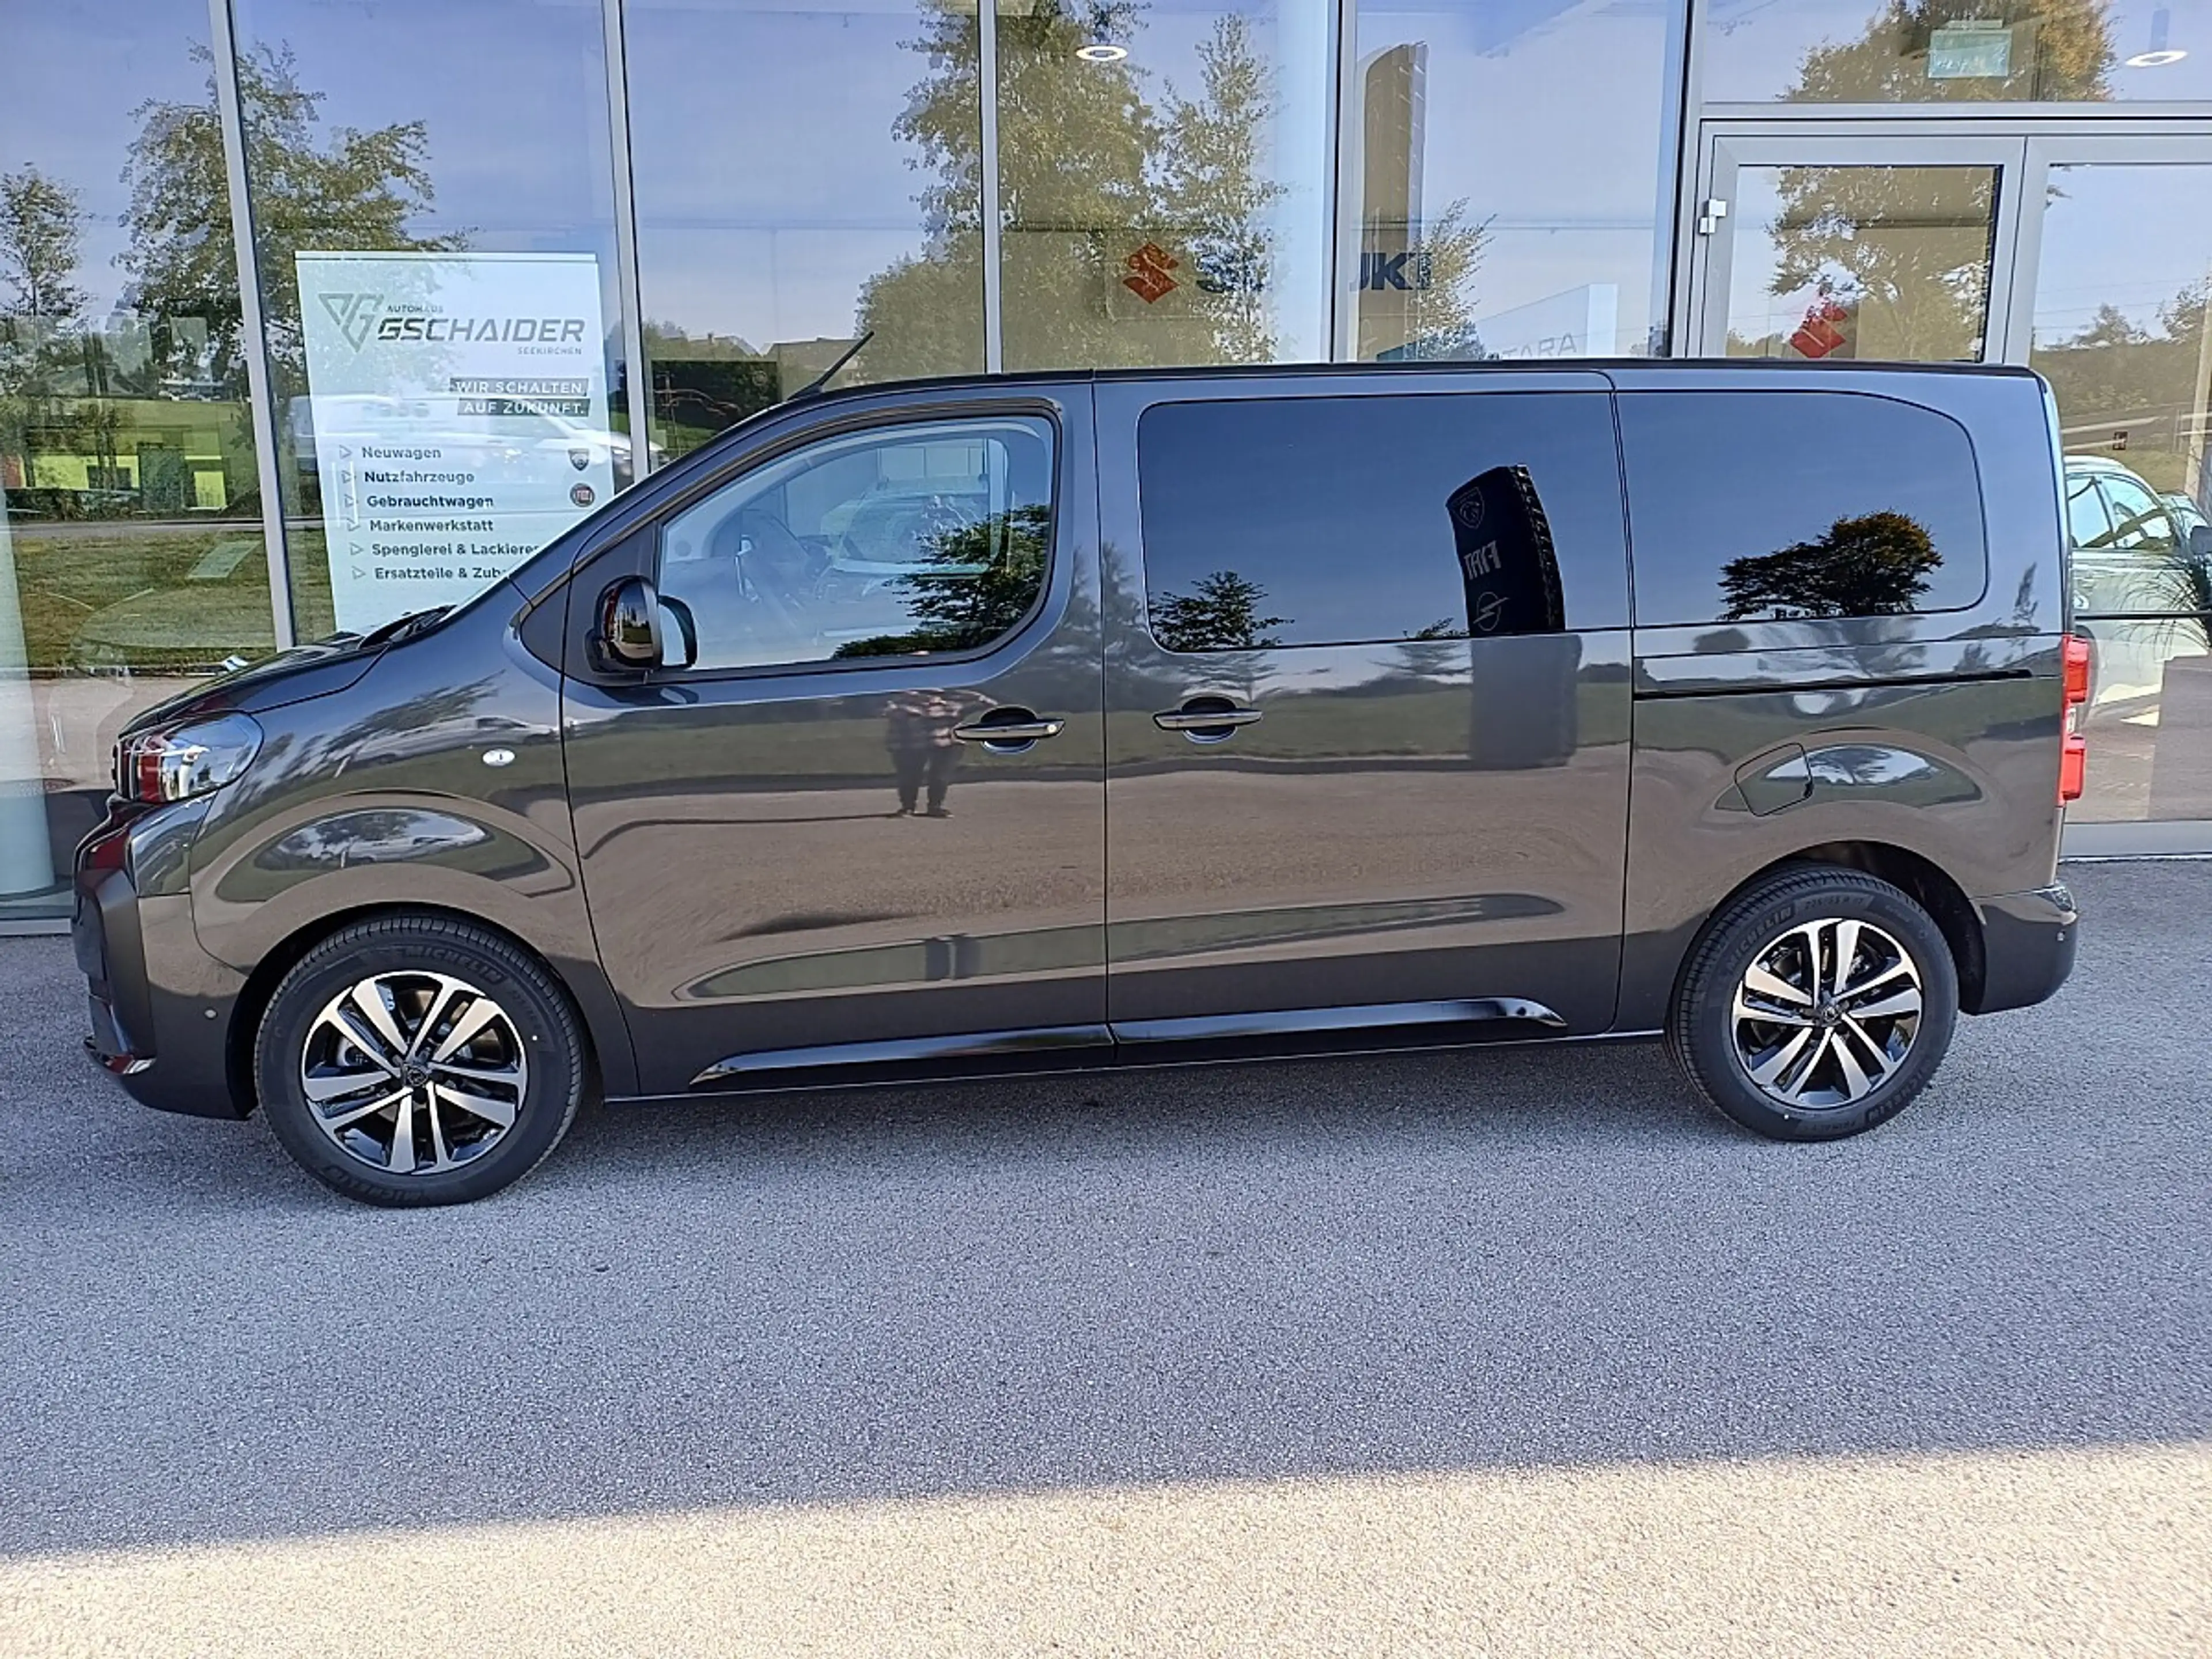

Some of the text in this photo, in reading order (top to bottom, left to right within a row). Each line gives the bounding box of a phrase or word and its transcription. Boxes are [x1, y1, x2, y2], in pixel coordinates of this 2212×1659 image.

[387, 305, 444, 313] AUTOHAUS
[377, 317, 585, 342] GSCHAIDER
[517, 346, 582, 355] SEEKIRCHEN
[456, 381, 489, 393] WIR
[464, 401, 584, 414] AUF ZUKUNFT.
[362, 446, 442, 460] Neuwagen
[364, 471, 475, 485] Nutzfahrzeuge
[366, 495, 493, 509] Gebrauchtwagen
[370, 520, 494, 532] Markenwerkstatt
[372, 543, 452, 557] Spenglerei
[457, 544, 466, 555] &
[375, 567, 507, 579] Ersatzteile & Zub
[1727, 906, 1792, 973] MICHELIN
[406, 945, 503, 982] MICHELIN
